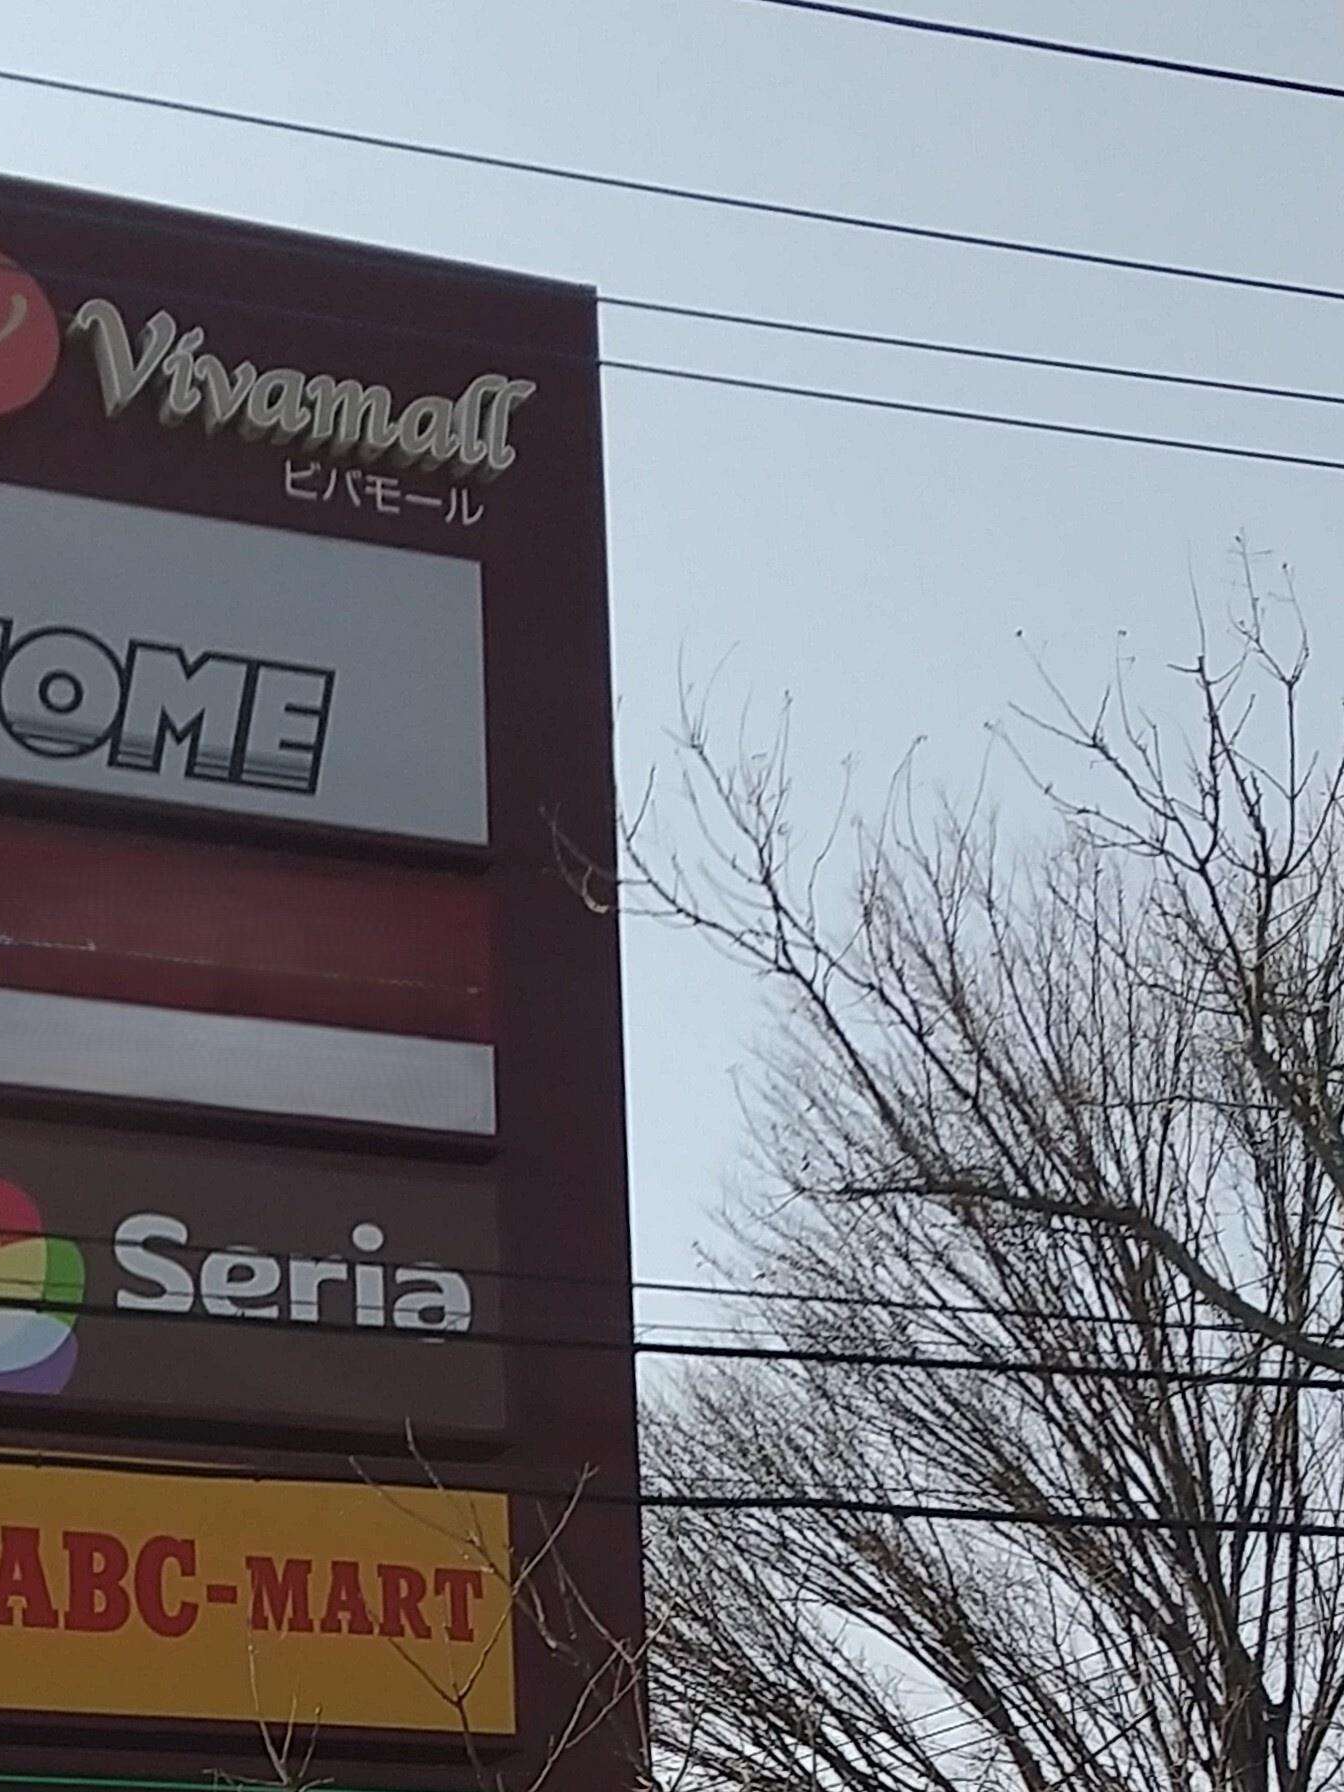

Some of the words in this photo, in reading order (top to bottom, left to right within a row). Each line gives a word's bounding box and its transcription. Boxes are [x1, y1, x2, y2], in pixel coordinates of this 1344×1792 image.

[68, 297, 536, 478] Vivamall
[284, 459, 485, 526] ビバモール
[113, 1211, 472, 1344] Seria
